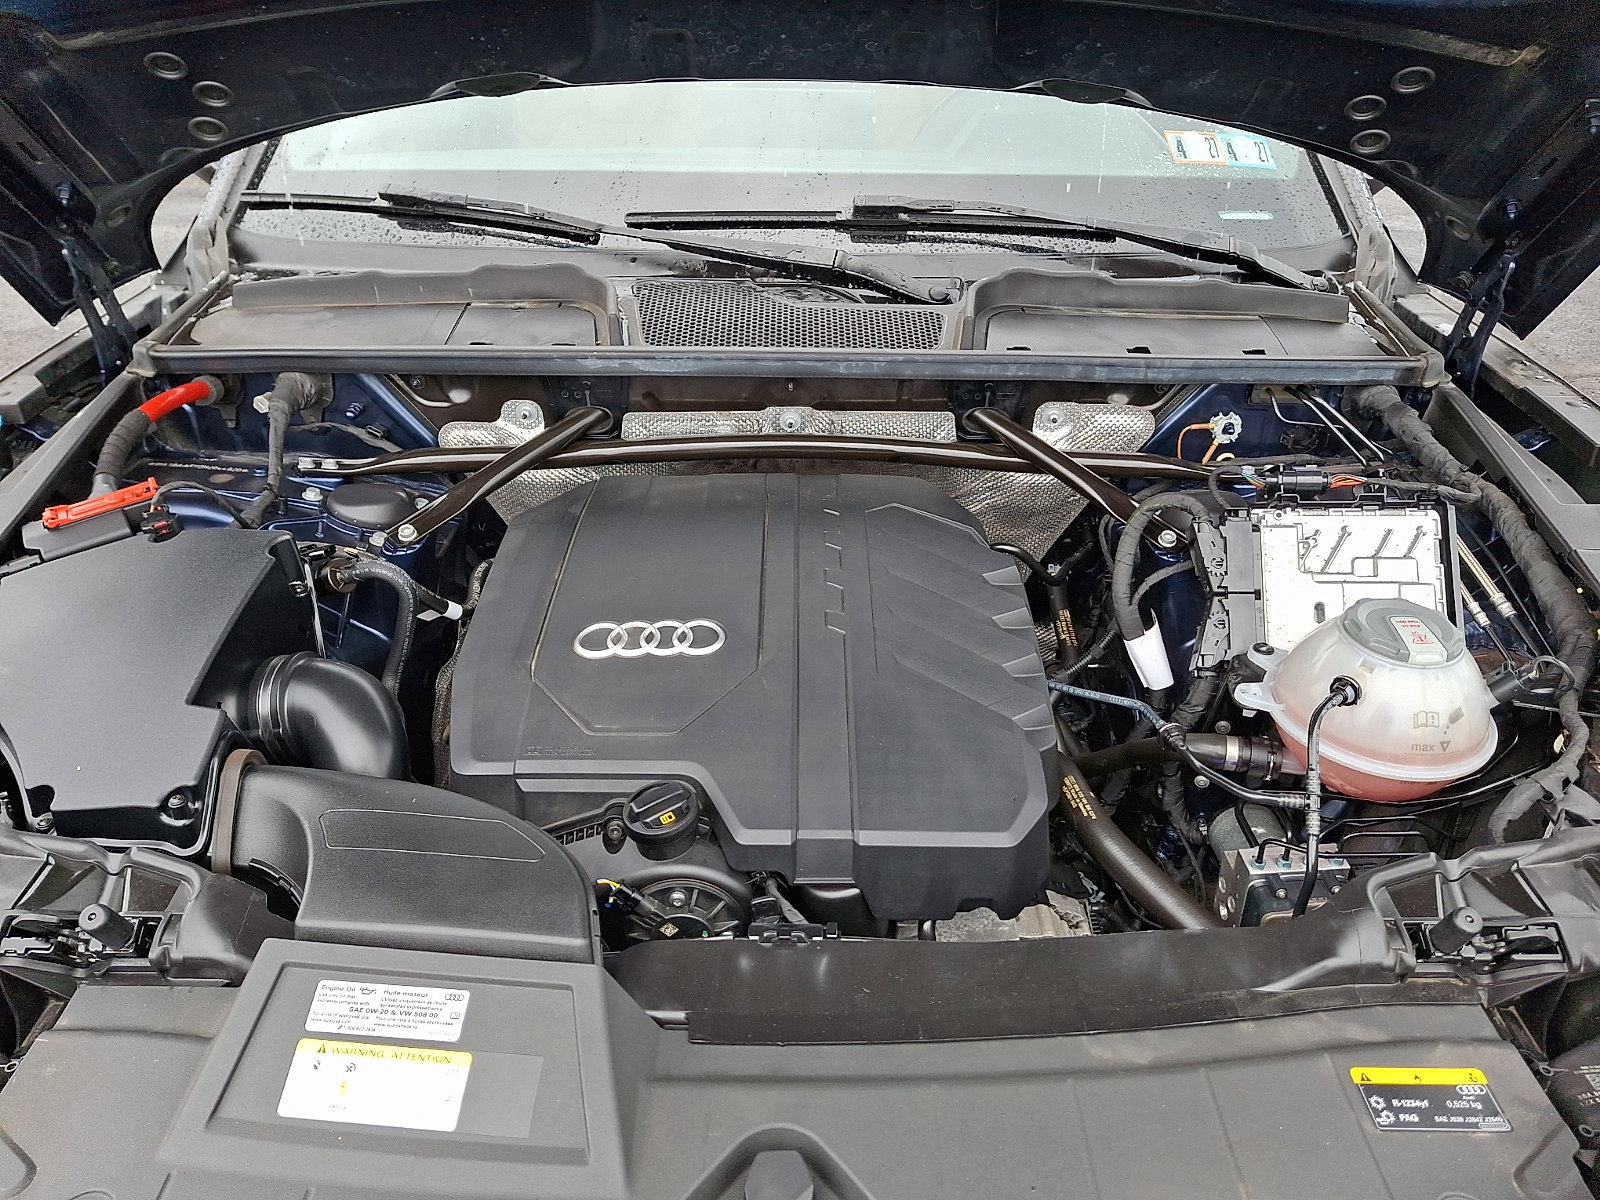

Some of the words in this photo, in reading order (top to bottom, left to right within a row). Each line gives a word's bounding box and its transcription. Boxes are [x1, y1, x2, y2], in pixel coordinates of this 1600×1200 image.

[1176, 139, 1188, 159] 4
[1226, 142, 1238, 162] 4
[1410, 743, 1435, 752] max
[331, 1048, 384, 1058] WARNING
[391, 1052, 452, 1064] ATTENTION
[1392, 1098, 1429, 1109] R-1234yf
[1446, 1100, 1470, 1109] 0,525
[1470, 1100, 1482, 1110] kg
[1398, 1114, 1419, 1122] PAG
